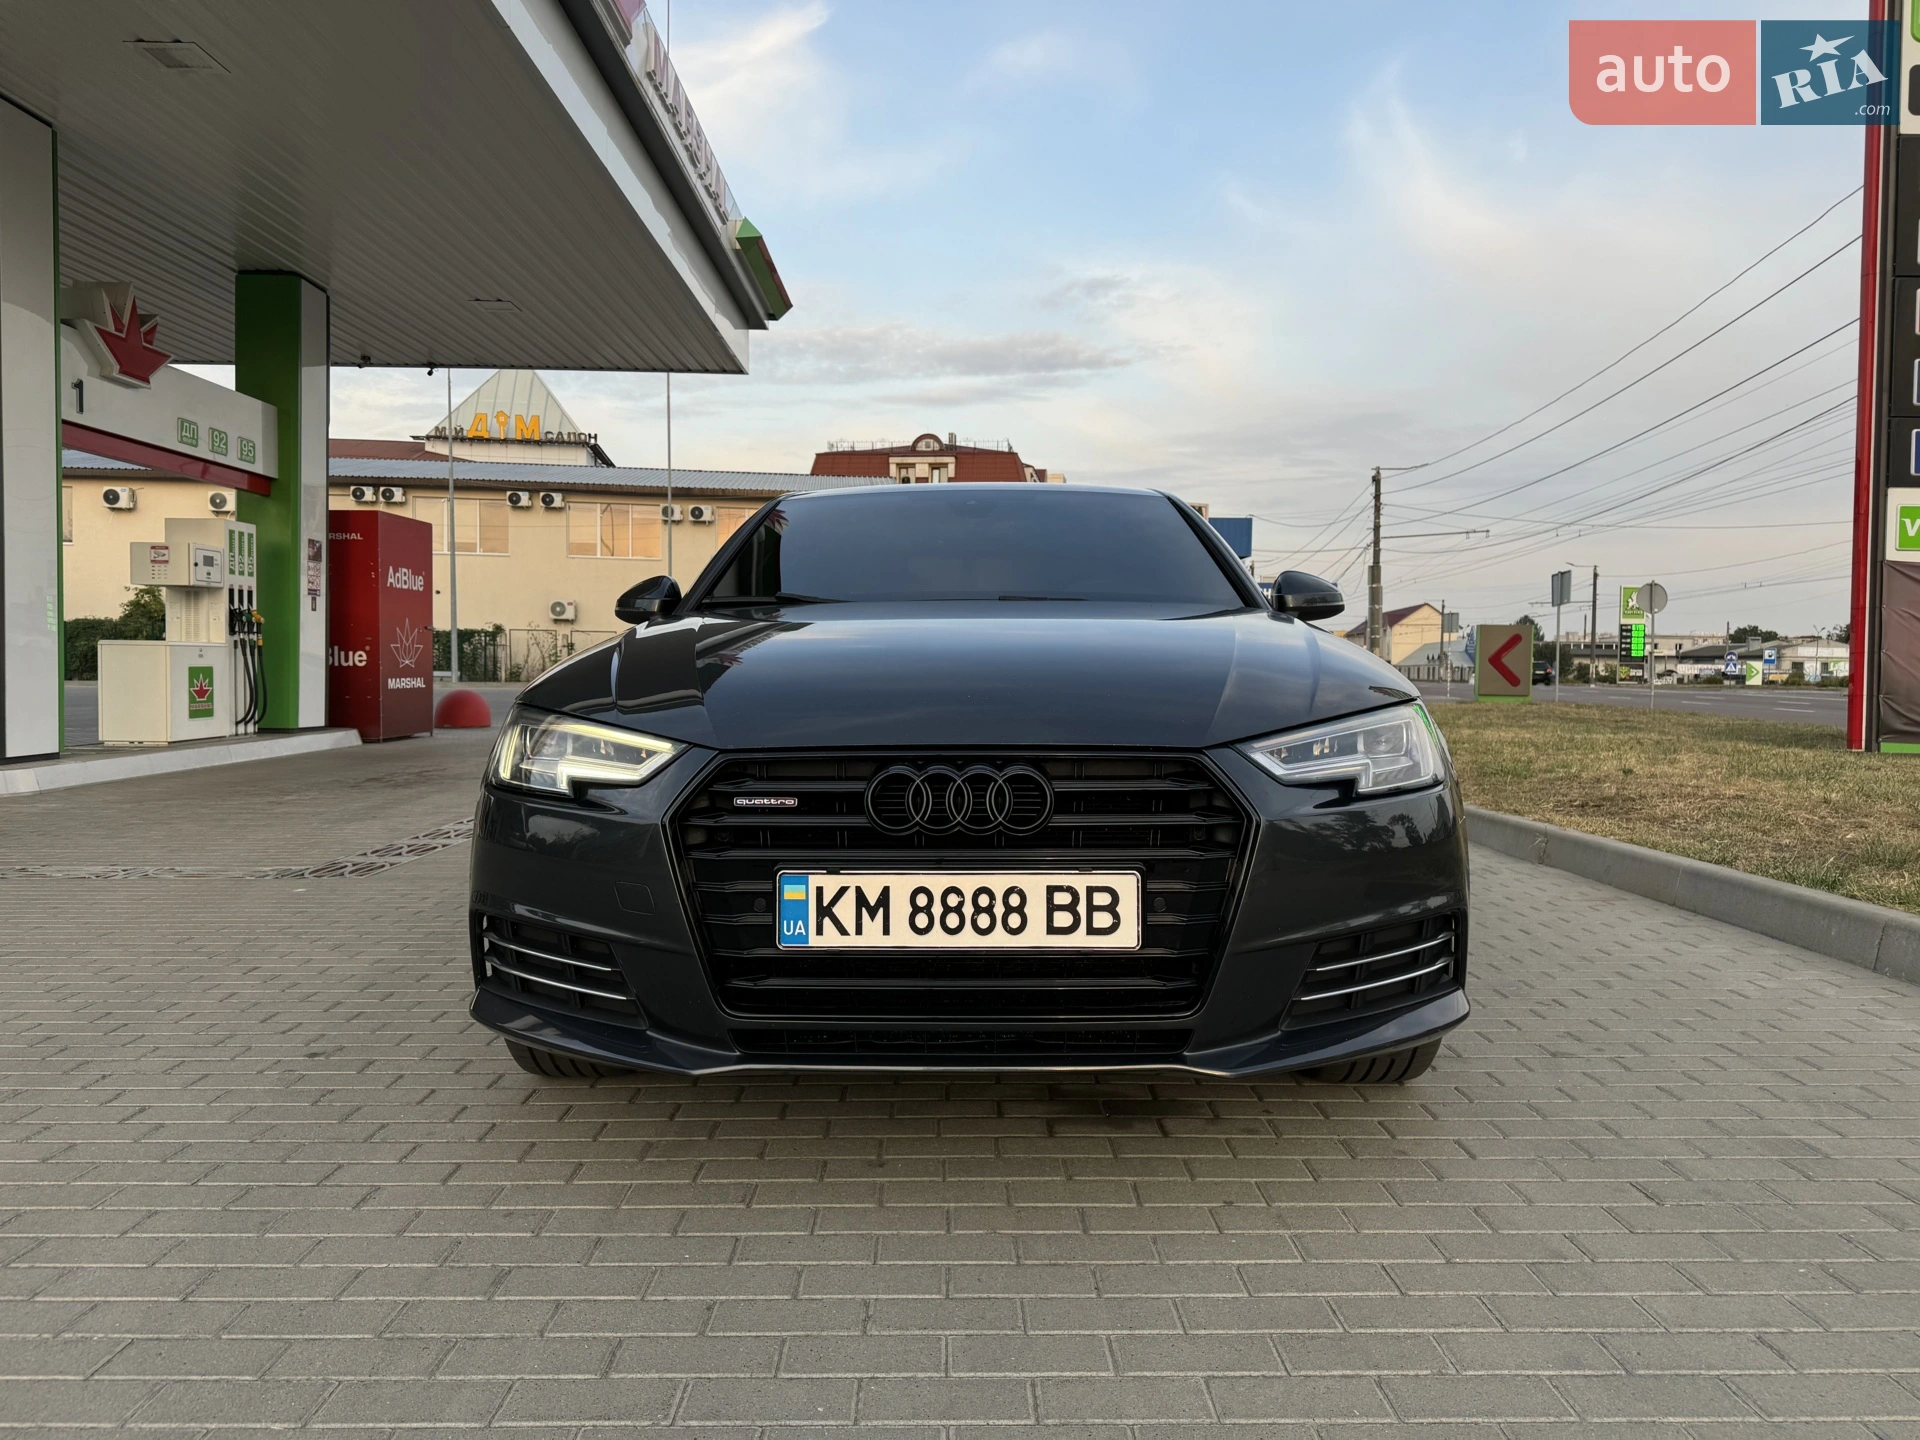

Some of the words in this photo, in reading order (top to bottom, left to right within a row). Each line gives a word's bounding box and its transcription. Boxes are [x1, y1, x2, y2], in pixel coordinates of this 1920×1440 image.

[71, 377, 84, 415] 1
[182, 422, 198, 439] ДП
[544, 431, 598, 444] САЛОН
[213, 431, 227, 449] 92
[241, 440, 254, 457] 95
[387, 566, 424, 591] AdBlue
[388, 677, 426, 690] MARSHAL
[736, 798, 795, 806] quattro
[815, 885, 890, 936] KM
[908, 885, 1027, 936] 8888
[1045, 884, 1122, 936] BB
[783, 920, 806, 936] UA
